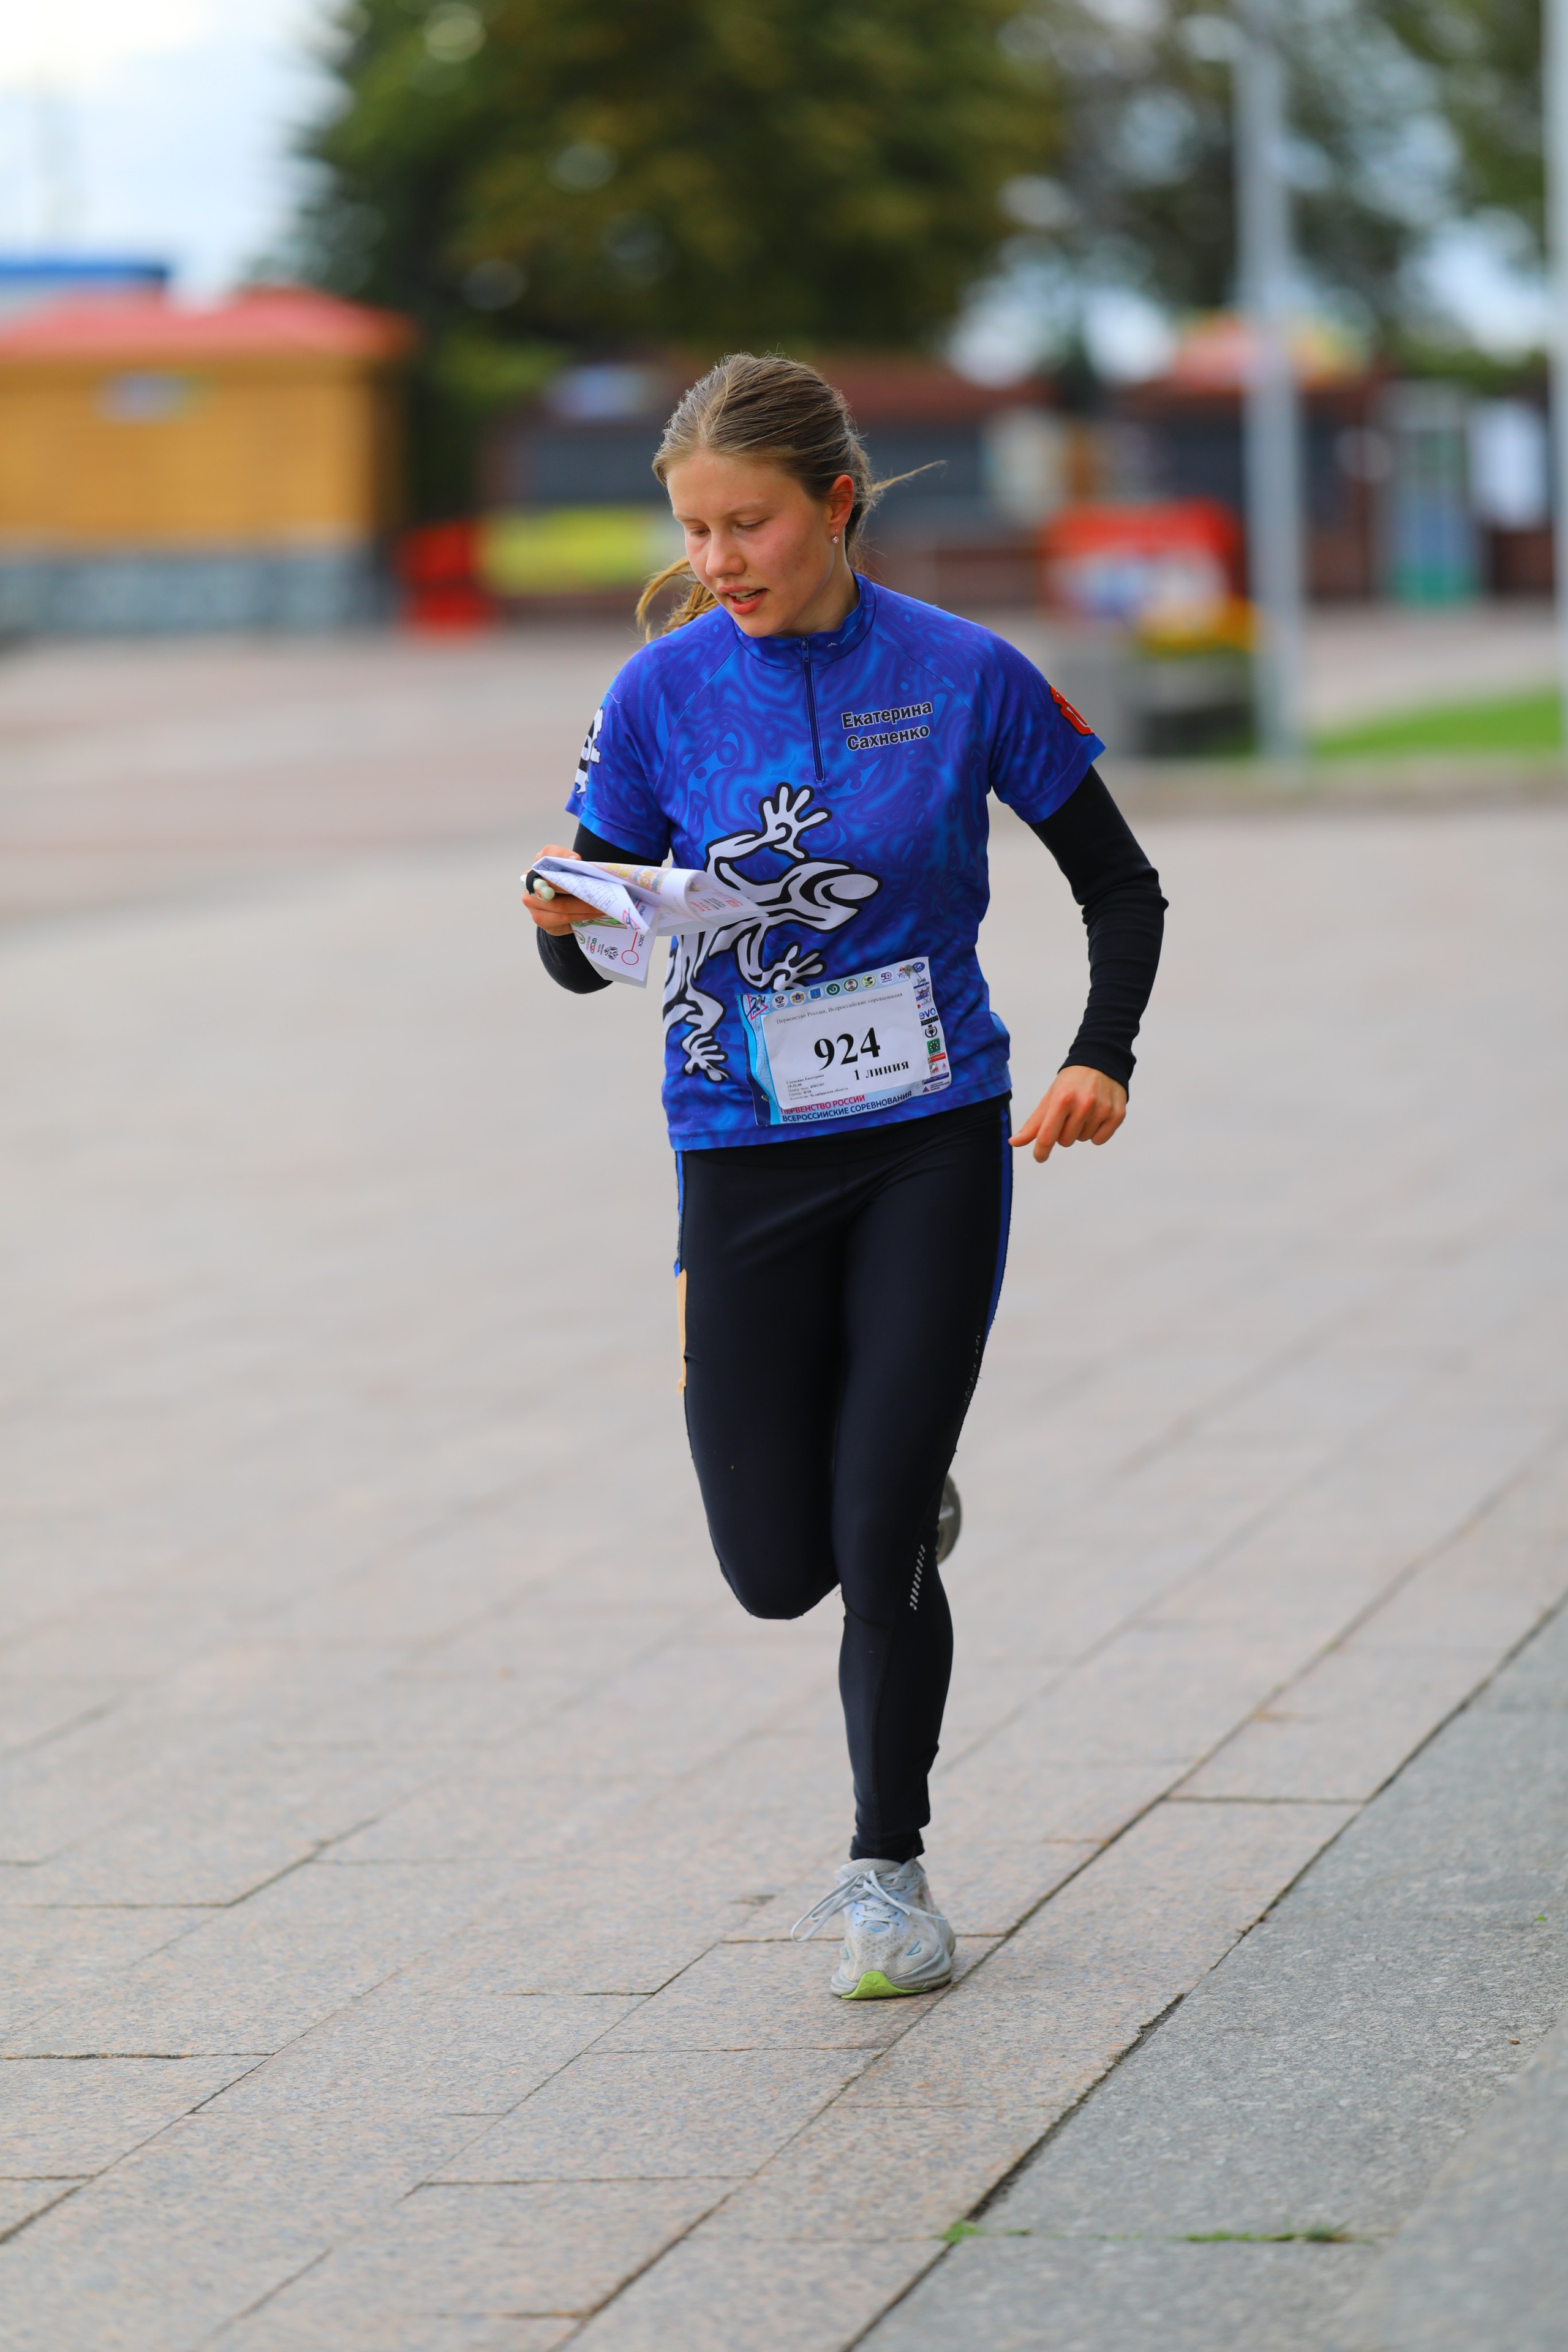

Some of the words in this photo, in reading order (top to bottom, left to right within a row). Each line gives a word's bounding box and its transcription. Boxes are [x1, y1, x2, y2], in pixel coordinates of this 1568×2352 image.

[842, 701, 933, 729] Екатерина
[846, 725, 930, 752] Сахненко
[777, 1014, 806, 1024] Первенство
[807, 1009, 827, 1017] России,
[828, 1000, 867, 1012] Всероссийские
[867, 993, 903, 1004] соревнования
[919, 1008, 937, 1020] evo
[814, 1027, 881, 1071] 924
[854, 1069, 860, 1080] 1
[865, 1061, 909, 1079] линия
[780, 1102, 831, 1114] ПЕРВЕНСТВО
[832, 1094, 865, 1107] РОССИИ
[850, 1090, 912, 1113] СОРЕВНОВАНИЯ
